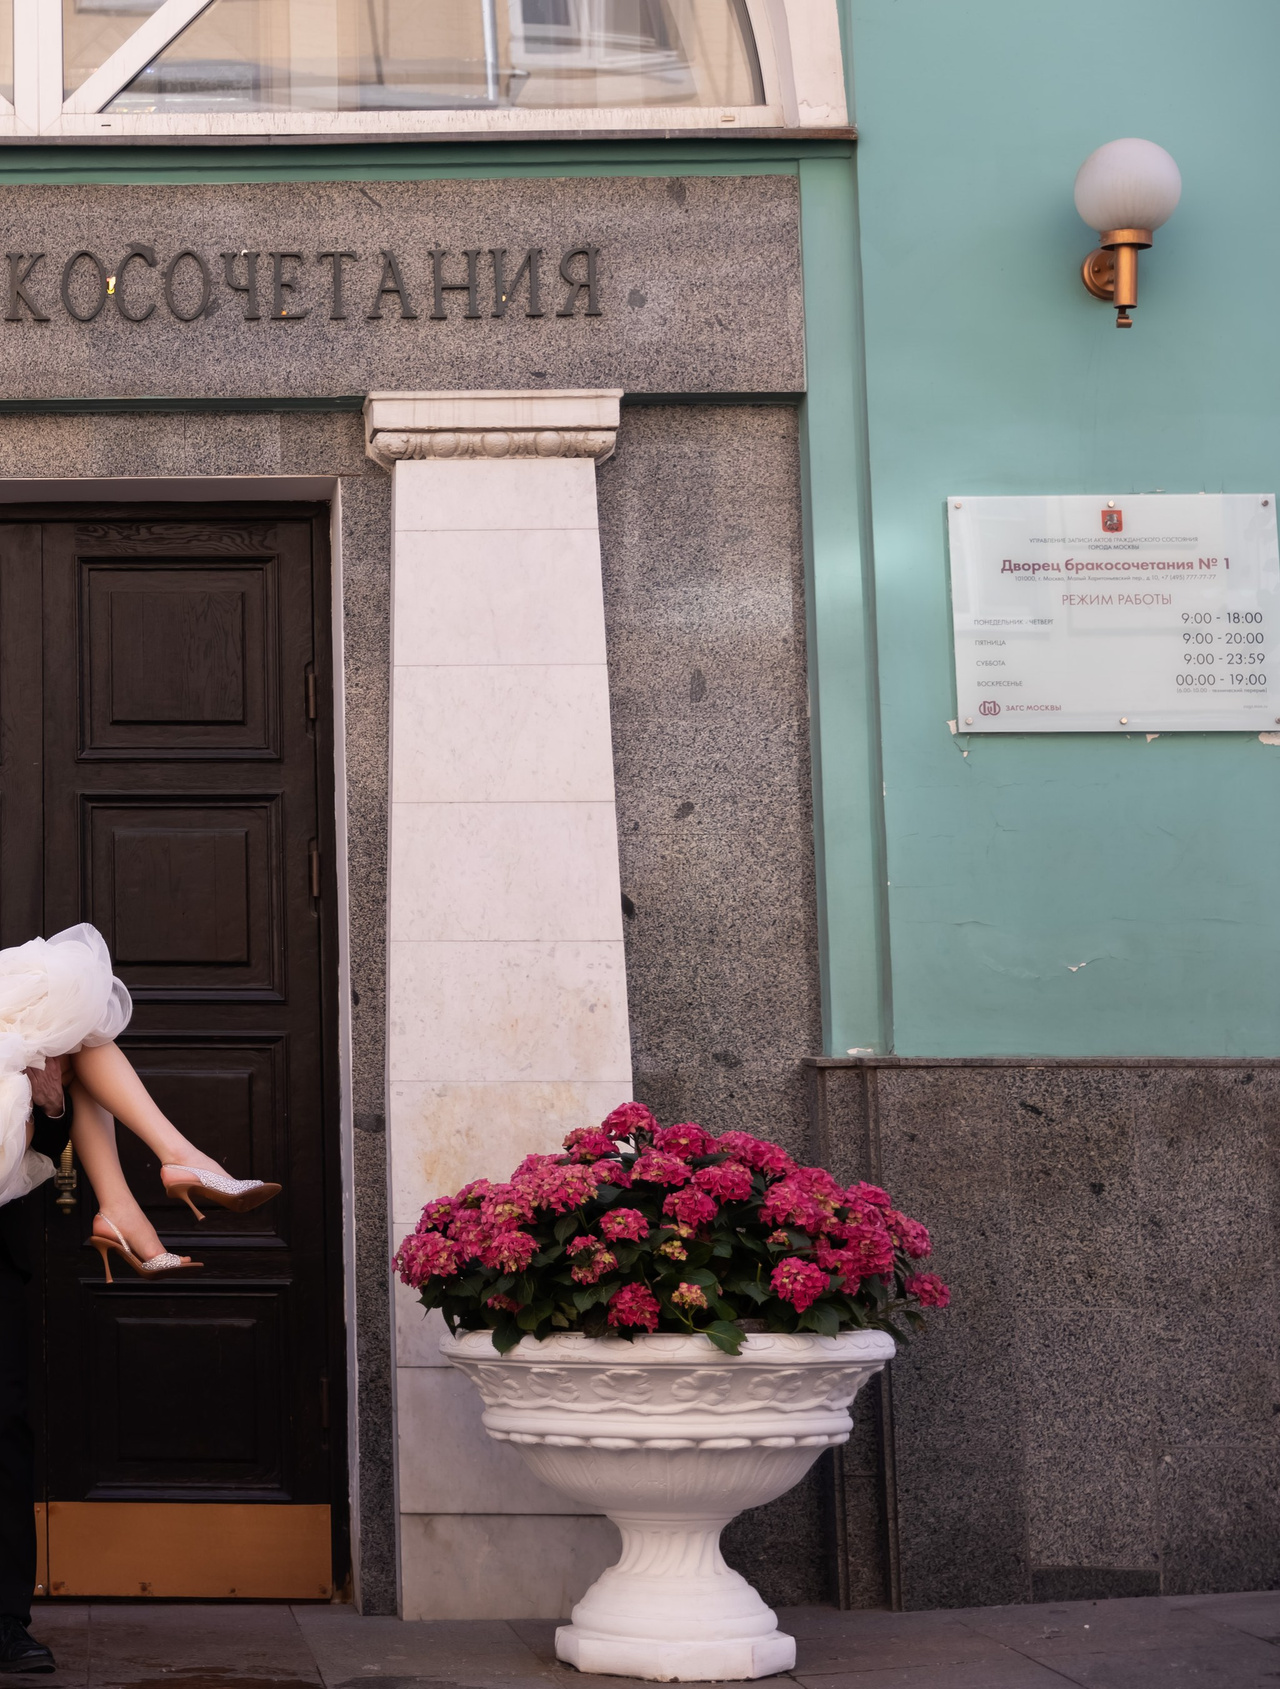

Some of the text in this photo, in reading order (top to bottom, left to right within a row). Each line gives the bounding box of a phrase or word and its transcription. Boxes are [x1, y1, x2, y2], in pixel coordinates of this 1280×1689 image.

[1001, 557, 1230, 575] Дворец бракосочетания № 1
[1062, 593, 1172, 605] РЕЖИМ РАБОТЫ
[1029, 618, 1054, 626] ЧЕТВЕРГ
[1181, 612, 1212, 624] 9:00
[1227, 611, 1263, 624] 18:00
[1182, 632, 1213, 644] 9:00
[1225, 632, 1264, 644] 20:00
[1183, 653, 1215, 665] 9:00
[1226, 652, 1265, 665] 23:59
[1175, 674, 1216, 686] 00:00
[1230, 673, 1267, 686] 19:00
